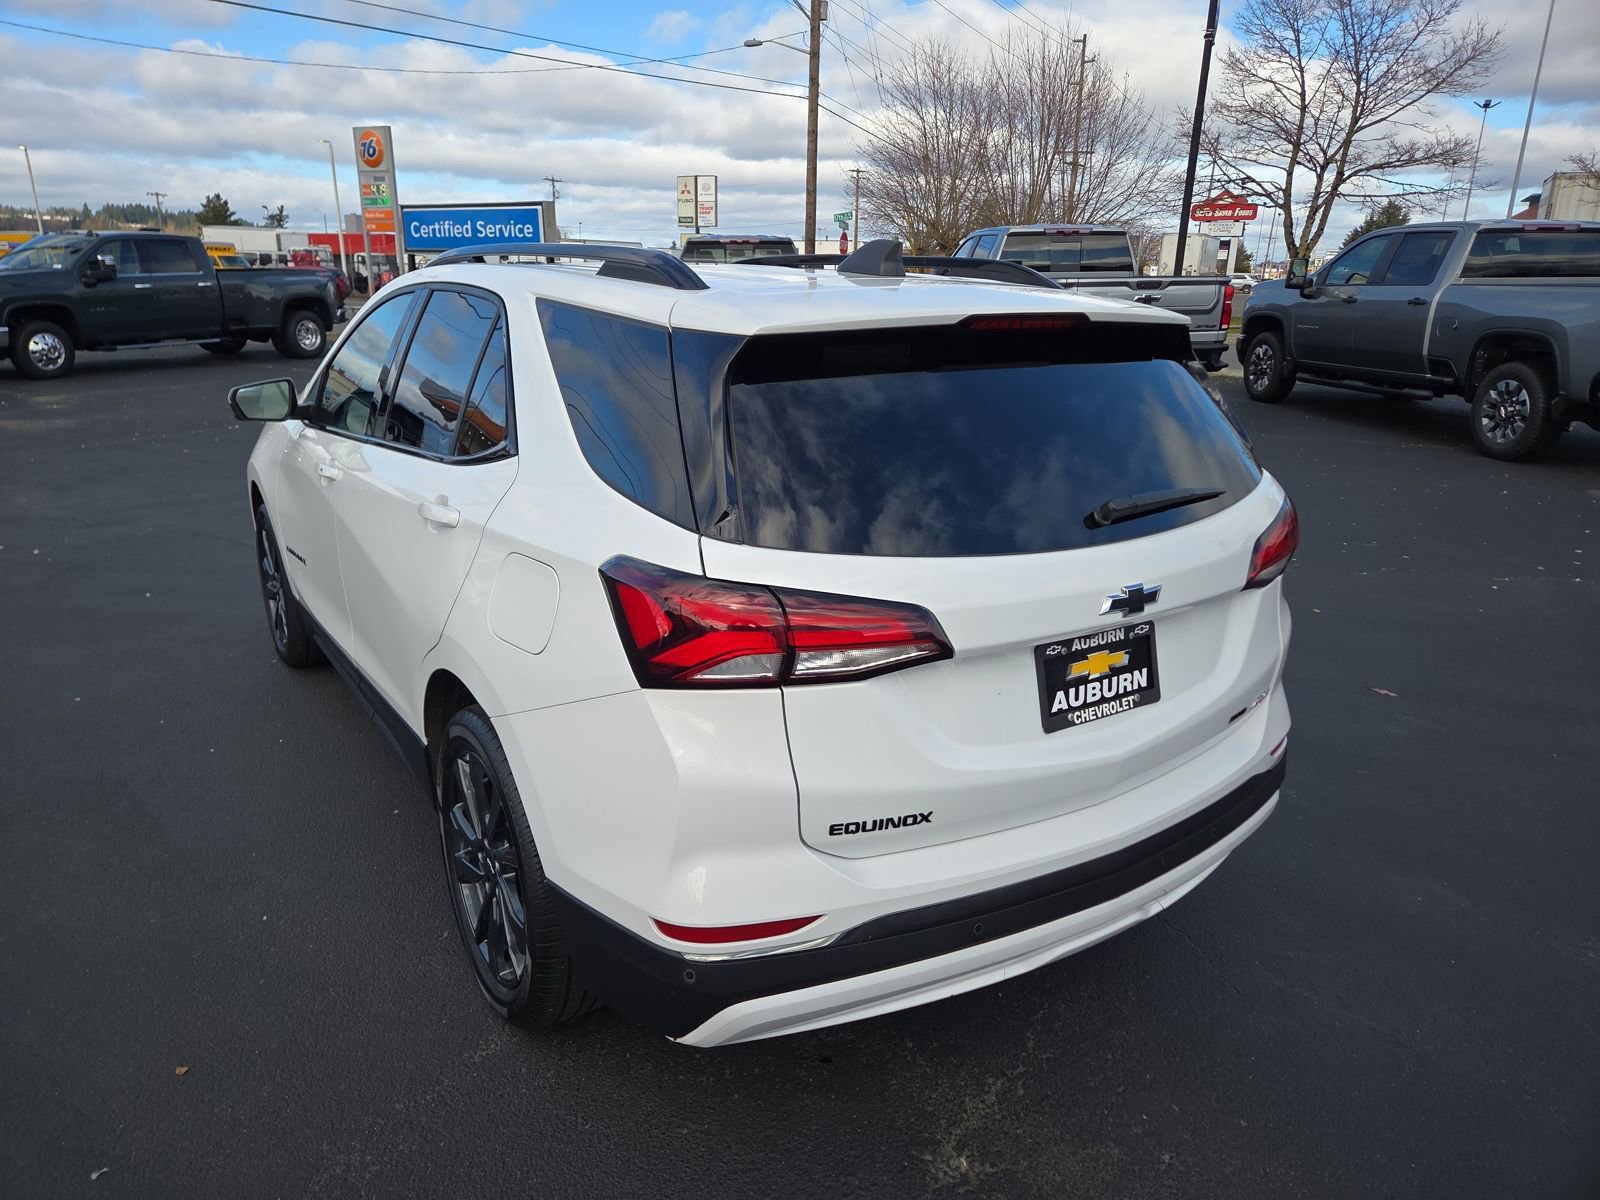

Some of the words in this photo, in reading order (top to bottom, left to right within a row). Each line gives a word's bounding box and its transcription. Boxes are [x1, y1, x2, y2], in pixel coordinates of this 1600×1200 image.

[360, 138, 377, 158] 76
[1234, 208, 1253, 217] FOODS
[410, 221, 472, 238] Certified
[476, 220, 534, 237] Service
[1071, 628, 1125, 652] AUBURN
[1051, 667, 1148, 714] AUBURN
[1073, 695, 1135, 724] CHEVROLET
[828, 811, 934, 837] EQUINOX
